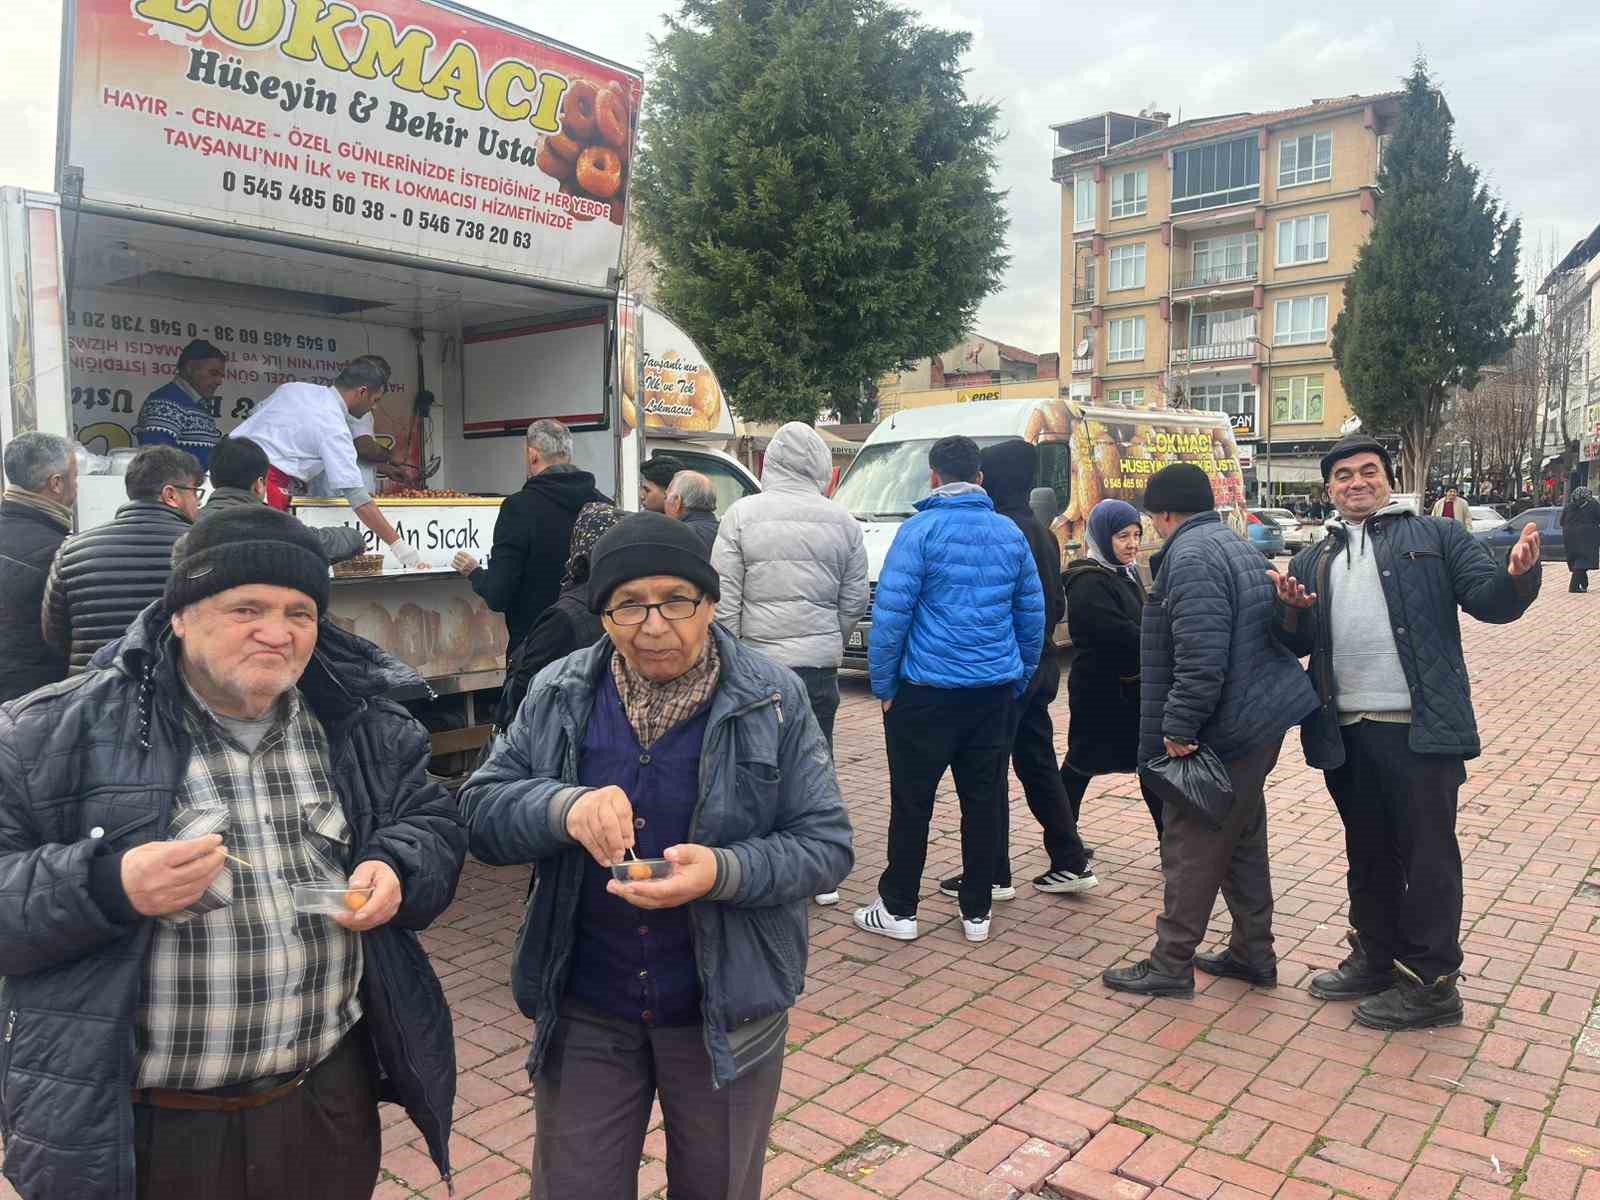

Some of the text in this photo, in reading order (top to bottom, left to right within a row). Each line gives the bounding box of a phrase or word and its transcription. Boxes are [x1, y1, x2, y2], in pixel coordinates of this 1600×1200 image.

[103, 87, 168, 117] HAYIR
[191, 107, 266, 138] CENAZE
[288, 126, 332, 154] ÖZEL
[337, 141, 455, 183] GÜNLERİNİZDE
[459, 166, 541, 202] İSTEDİĞİNİZ
[544, 192, 571, 210] HER
[572, 197, 610, 218] YERDE
[186, 48, 536, 167] Hüseyin & Bekir Usta
[223, 171, 236, 192] 0
[243, 175, 282, 201] 545
[289, 184, 326, 210] 485
[332, 193, 355, 215] 60
[362, 200, 385, 221] 38
[402, 208, 413, 227] 0
[418, 212, 450, 234] 546
[456, 218, 484, 241] 738
[489, 226, 509, 245] 20
[513, 231, 532, 249] 63
[305, 154, 332, 178] İLK
[337, 169, 355, 183] ve
[361, 171, 390, 191] TEK
[395, 179, 477, 211] LOKMACISI
[481, 197, 575, 230] HİZMETİNİZDE
